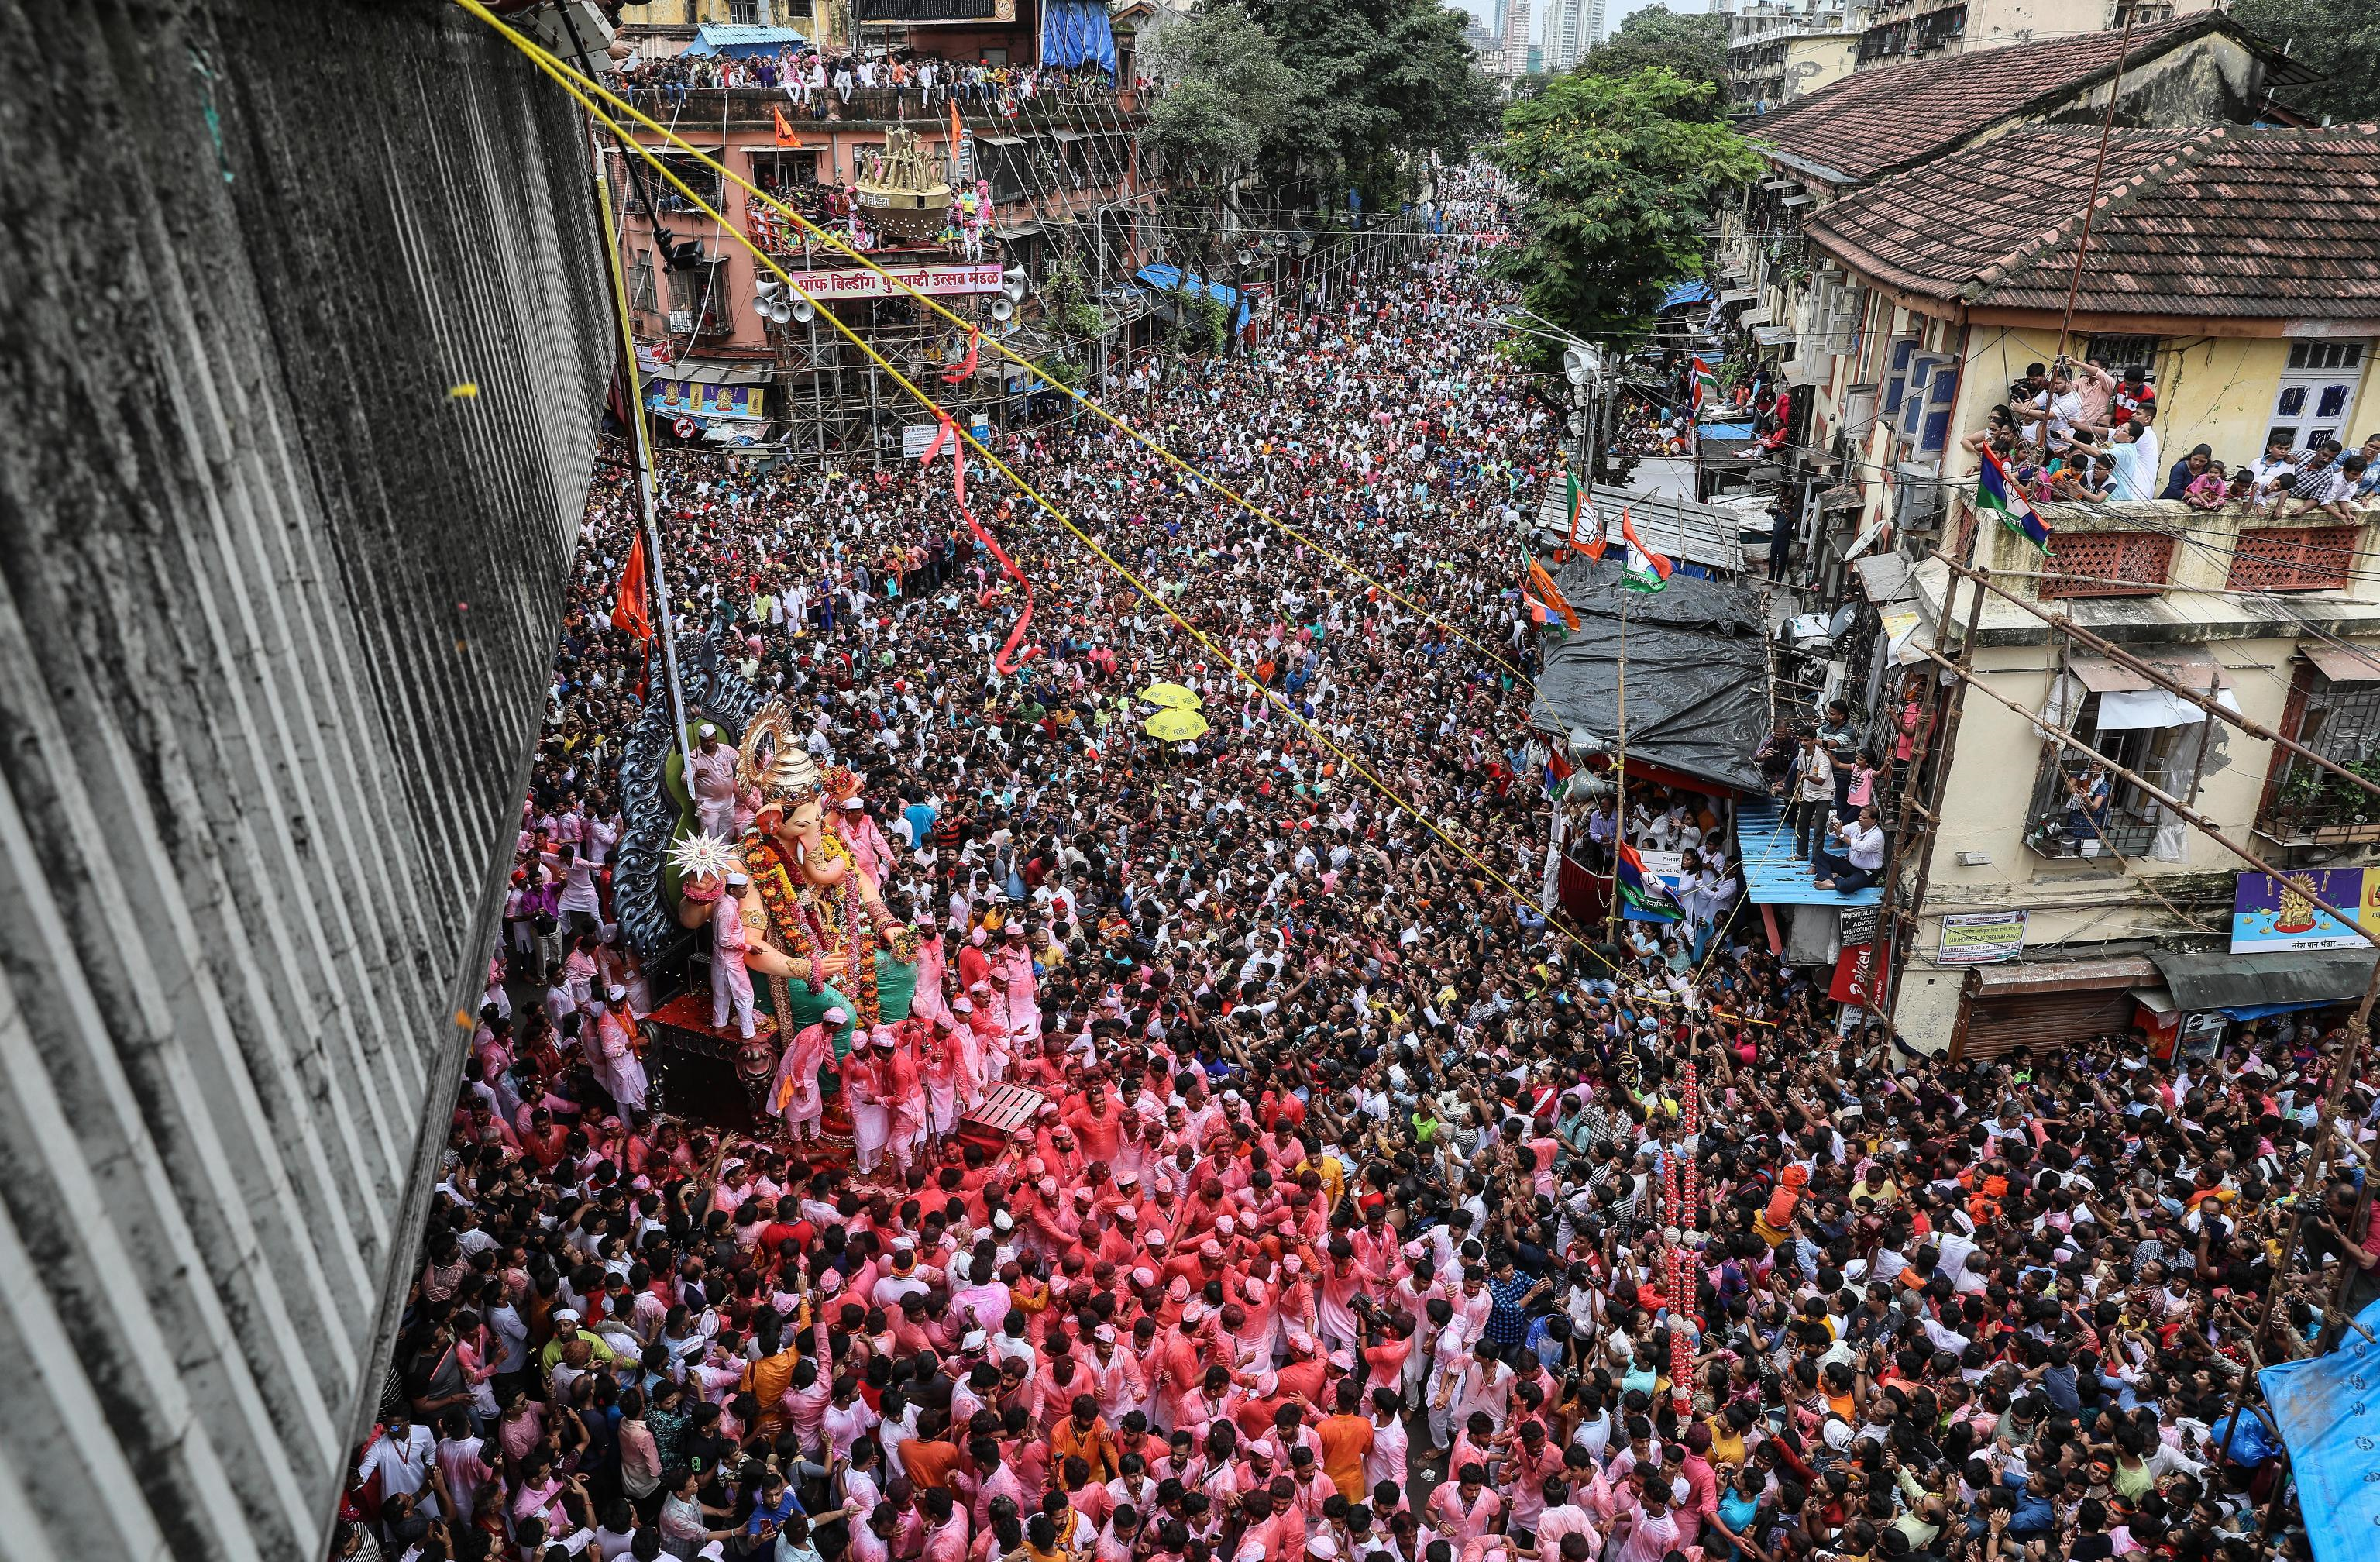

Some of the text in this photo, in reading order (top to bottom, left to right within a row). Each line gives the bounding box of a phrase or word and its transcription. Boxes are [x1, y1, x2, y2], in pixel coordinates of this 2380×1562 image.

[932, 273, 966, 287] उत्सव
[2292, 941, 2306, 949] नरेश
[2320, 939, 2337, 948] भंडार
[1852, 950, 1872, 983] airtel
[692, 1457, 701, 1471] 8
